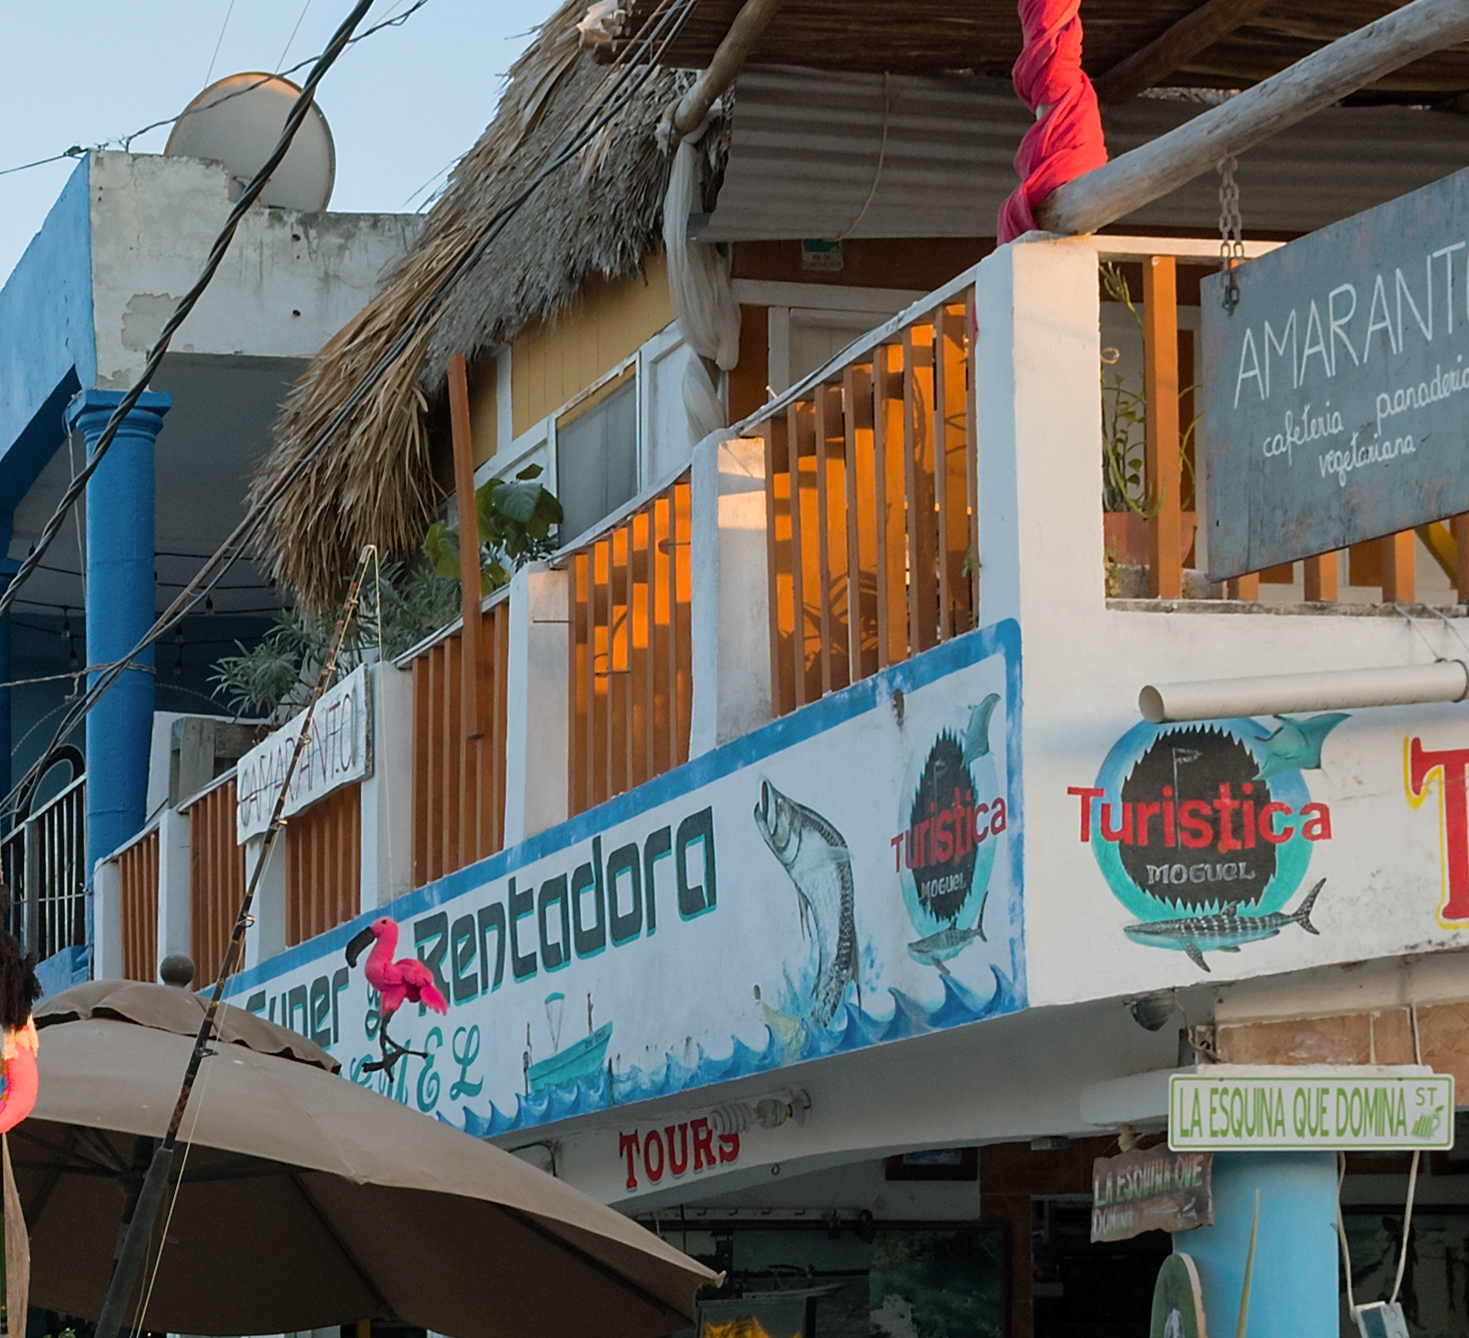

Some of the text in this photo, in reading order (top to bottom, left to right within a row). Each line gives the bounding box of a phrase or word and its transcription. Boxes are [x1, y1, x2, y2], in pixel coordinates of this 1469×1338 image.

[1263, 400, 1344, 466] cafeteria
[1318, 432, 1416, 487] vegetariana
[891, 787, 1006, 873] Turistica
[1067, 781, 1333, 850] Turistica
[414, 806, 717, 1019] Rentadora
[1179, 1087, 1438, 1139] LA ESQUINA QUE DOMINA ST
[619, 1116, 741, 1192] TOURS
[1094, 1155, 1203, 1206] LA ESQUINA QUE
